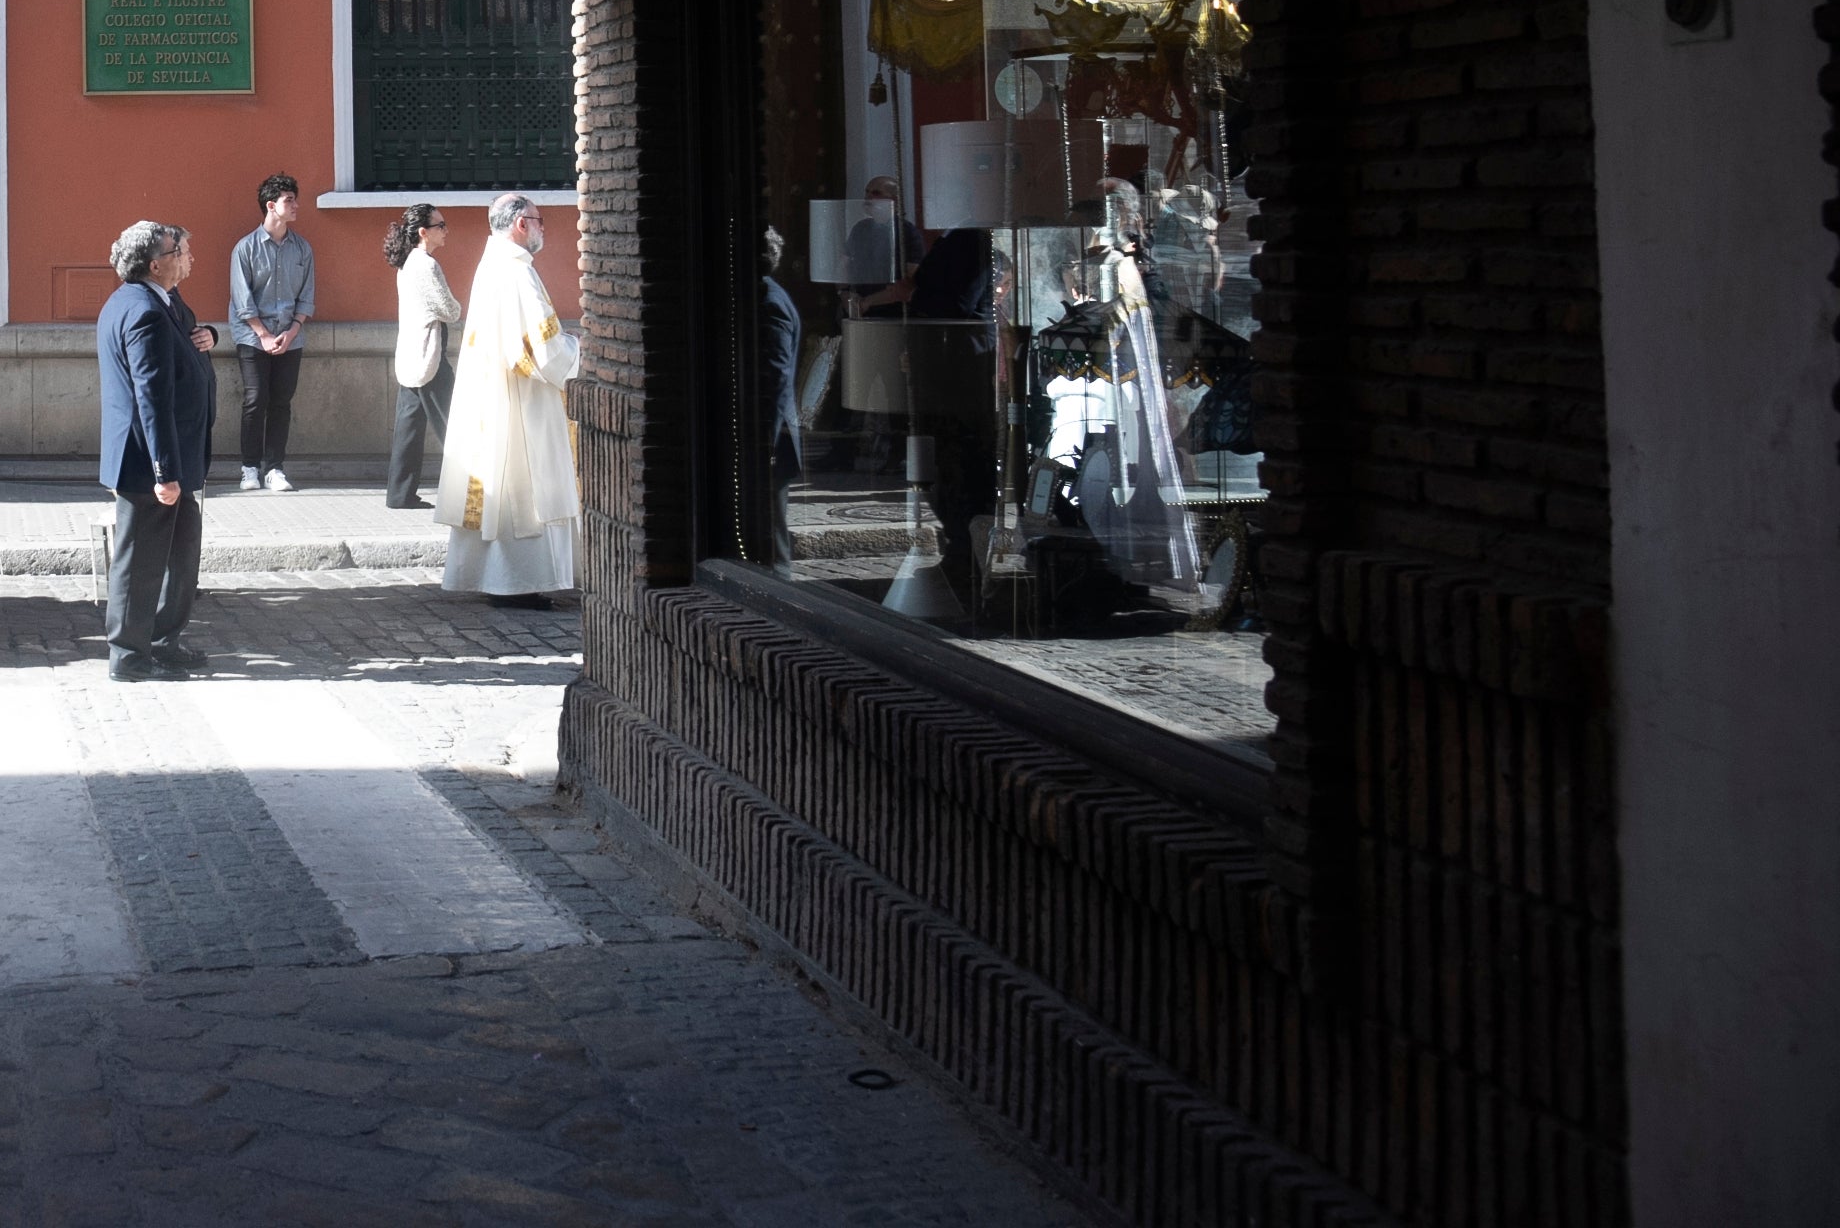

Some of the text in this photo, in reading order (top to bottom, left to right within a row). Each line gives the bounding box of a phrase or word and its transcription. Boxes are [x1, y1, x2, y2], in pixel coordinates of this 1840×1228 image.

[105, 14, 231, 27] COLEGIO OFICIAL
[99, 32, 238, 46] DE FARMACEUTICOS
[105, 52, 231, 65] DE LA PROVINCIA
[127, 71, 211, 84] DE SEVILLA
